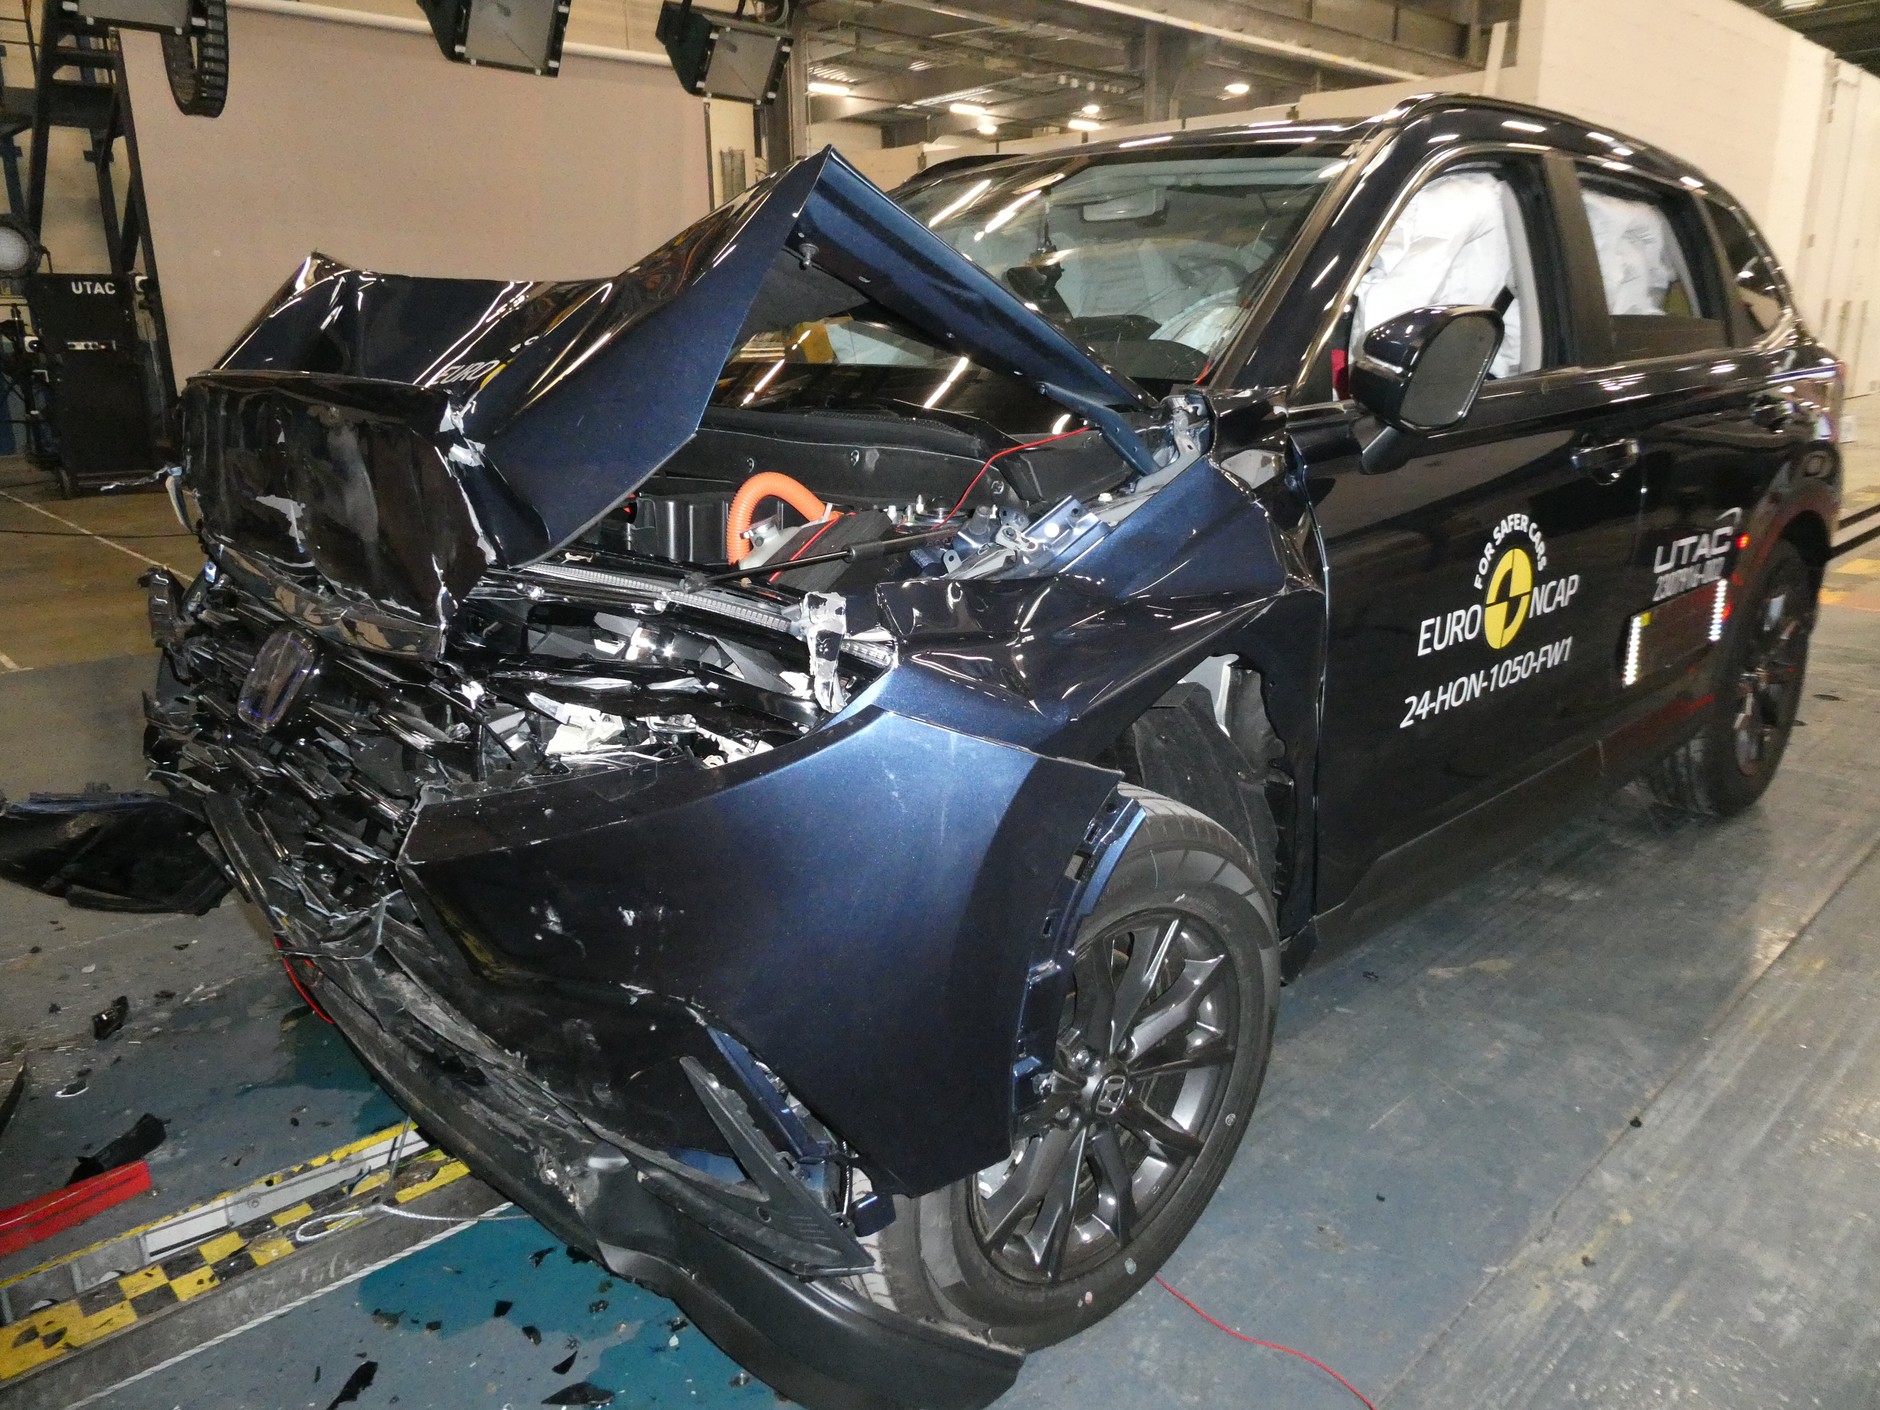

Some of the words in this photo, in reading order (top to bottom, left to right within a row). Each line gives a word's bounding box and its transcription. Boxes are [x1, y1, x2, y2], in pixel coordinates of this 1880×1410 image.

[71, 281, 116, 295] UTAC
[429, 359, 500, 385] EURO
[1473, 542, 1496, 590] FOR
[1492, 513, 1530, 546] SAFER
[1528, 522, 1547, 572] CARS
[1653, 526, 1734, 574] UTAC
[1417, 604, 1482, 657] EURO
[1528, 574, 1580, 619] NCAP
[1400, 636, 1573, 729] 24-HON-1050-FW1
